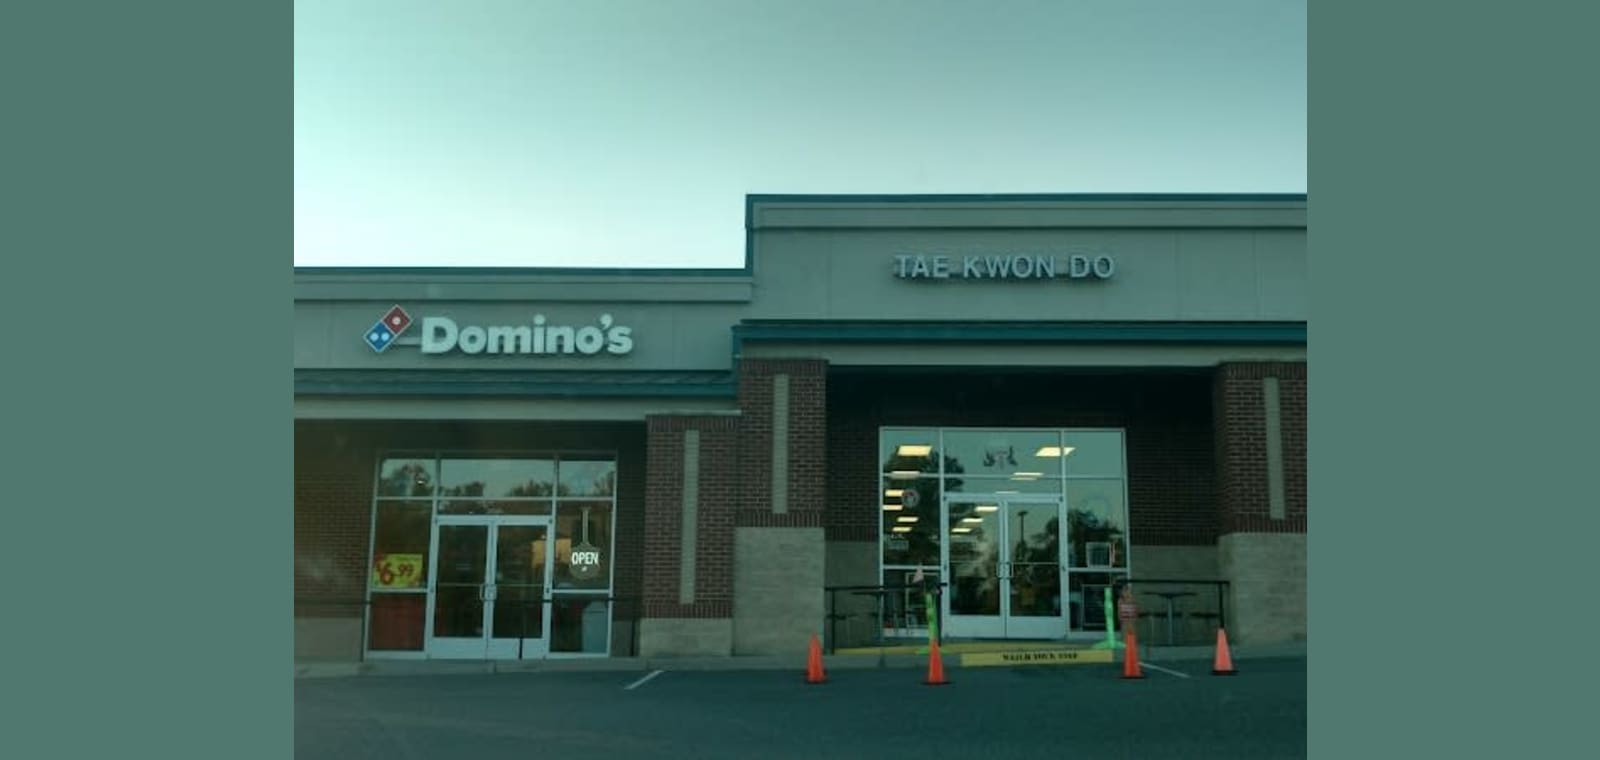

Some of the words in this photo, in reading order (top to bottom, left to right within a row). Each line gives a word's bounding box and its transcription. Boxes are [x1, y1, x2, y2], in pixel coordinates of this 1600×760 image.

[896, 255, 950, 278] TAE
[963, 255, 1055, 278] KWON
[1070, 255, 1115, 278] DO
[421, 313, 632, 354] Domino's
[571, 551, 599, 565] OPEN
